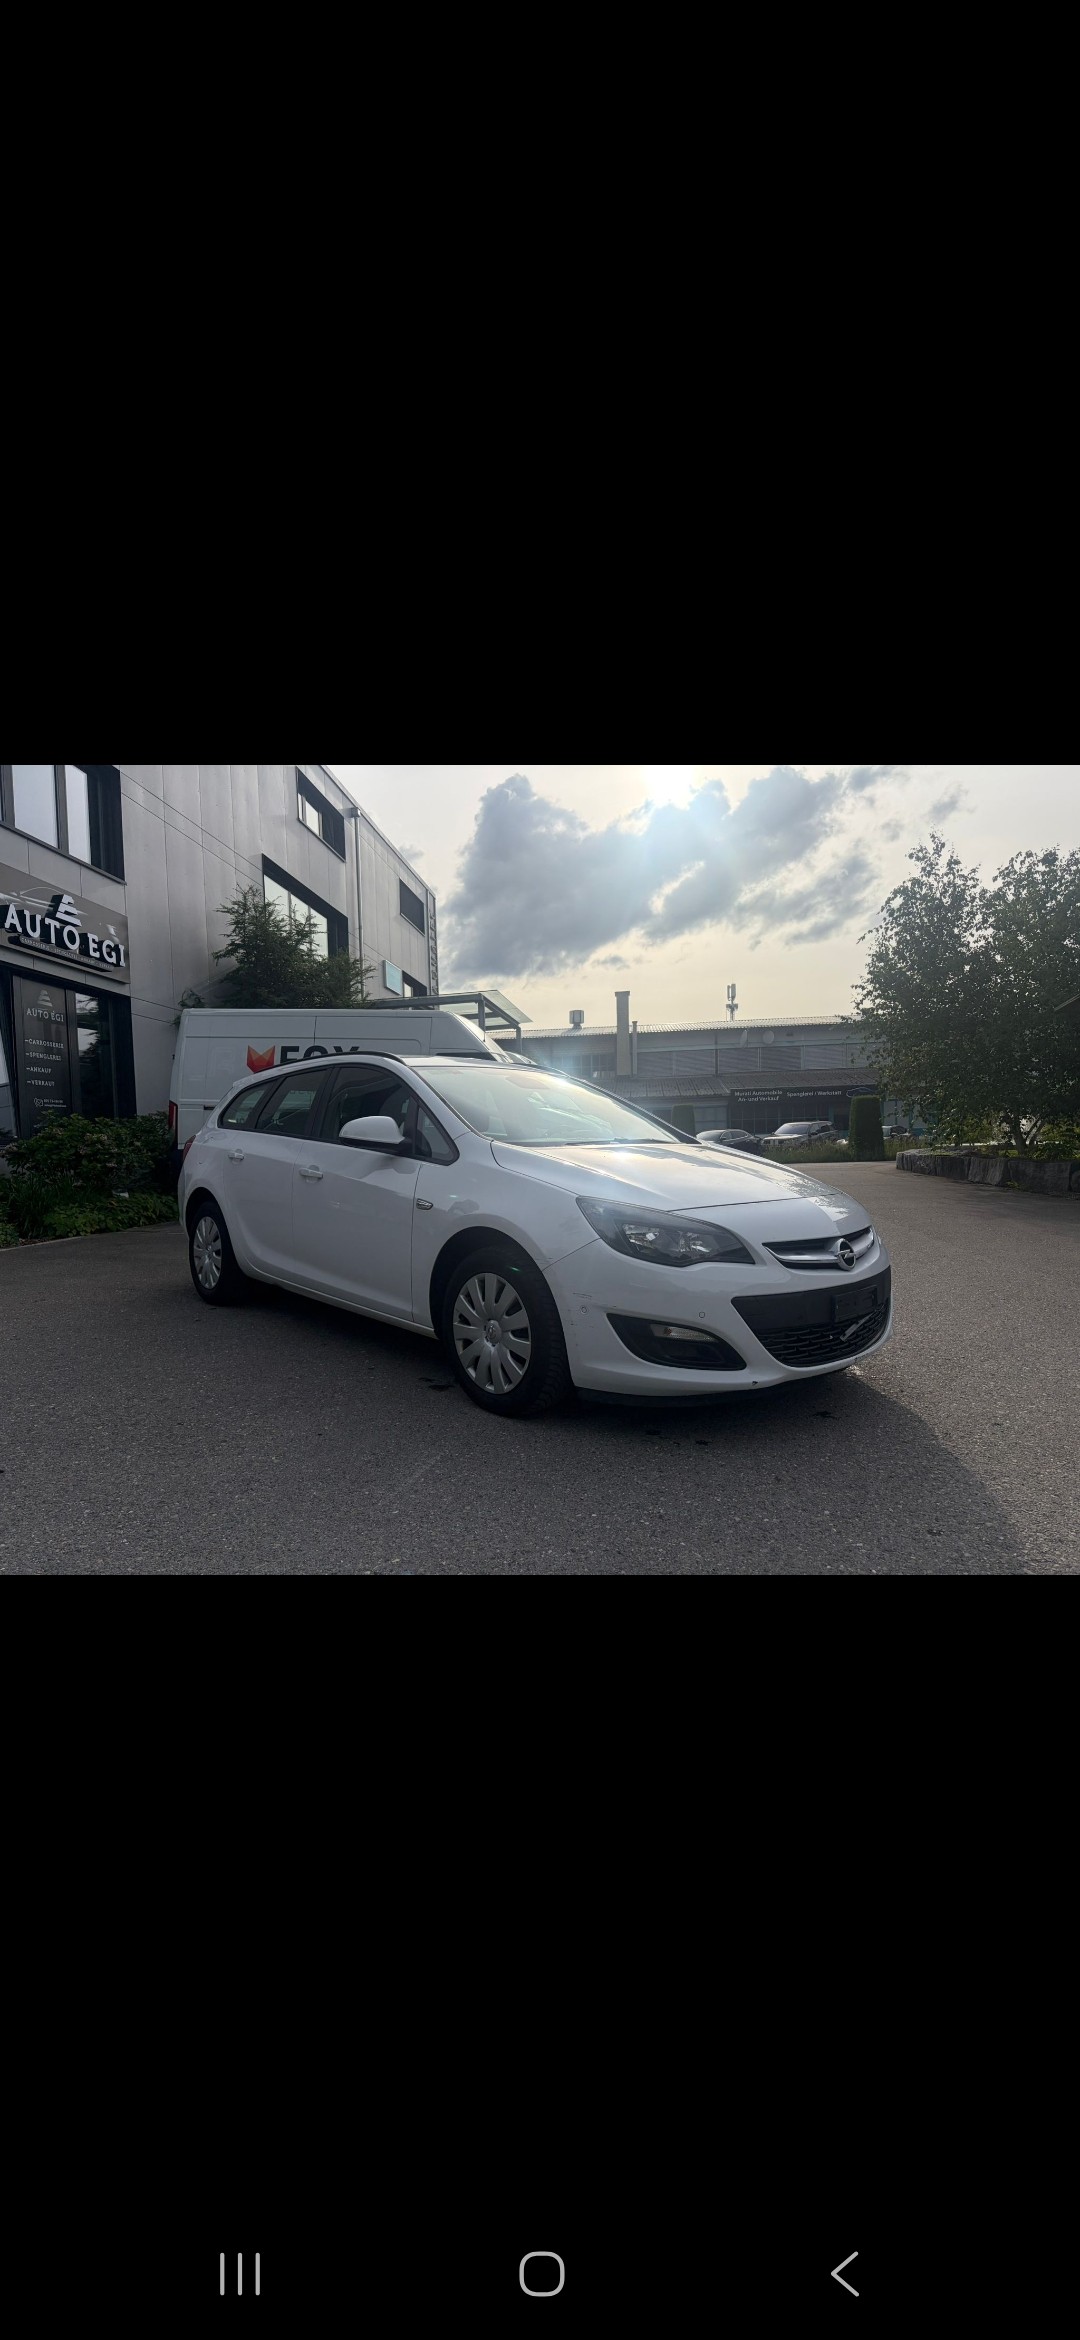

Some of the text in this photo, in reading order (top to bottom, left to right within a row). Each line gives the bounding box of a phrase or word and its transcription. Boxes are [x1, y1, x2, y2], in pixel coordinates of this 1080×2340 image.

[4, 903, 126, 968] AUTO EGI
[26, 1007, 49, 1019] AUTO
